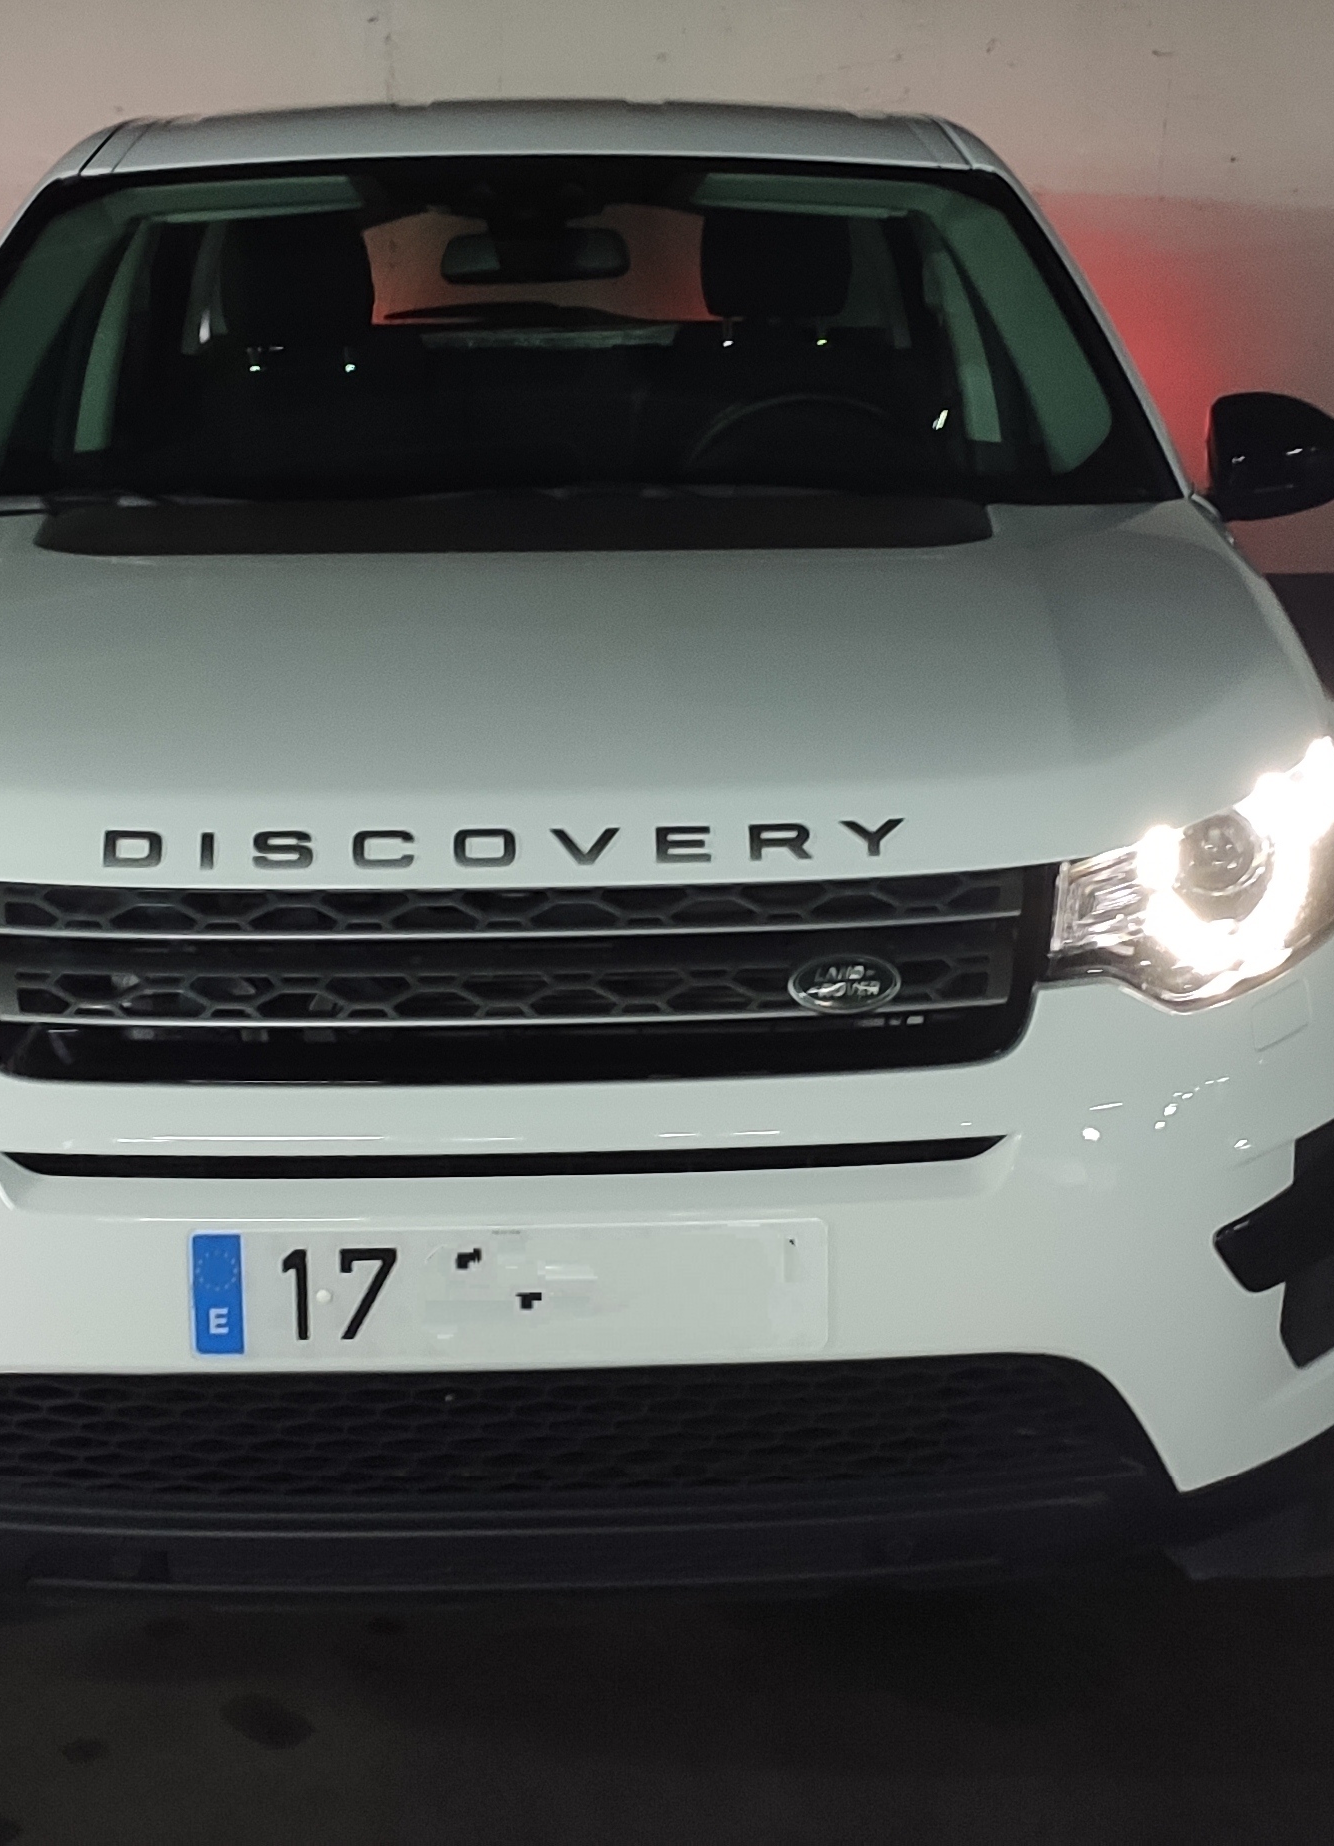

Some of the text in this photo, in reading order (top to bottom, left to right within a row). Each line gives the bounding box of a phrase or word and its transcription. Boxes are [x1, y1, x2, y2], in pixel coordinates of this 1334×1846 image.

[102, 816, 906, 870] DISCOVERY
[208, 1307, 230, 1335] E
[280, 1246, 399, 1342] 17
